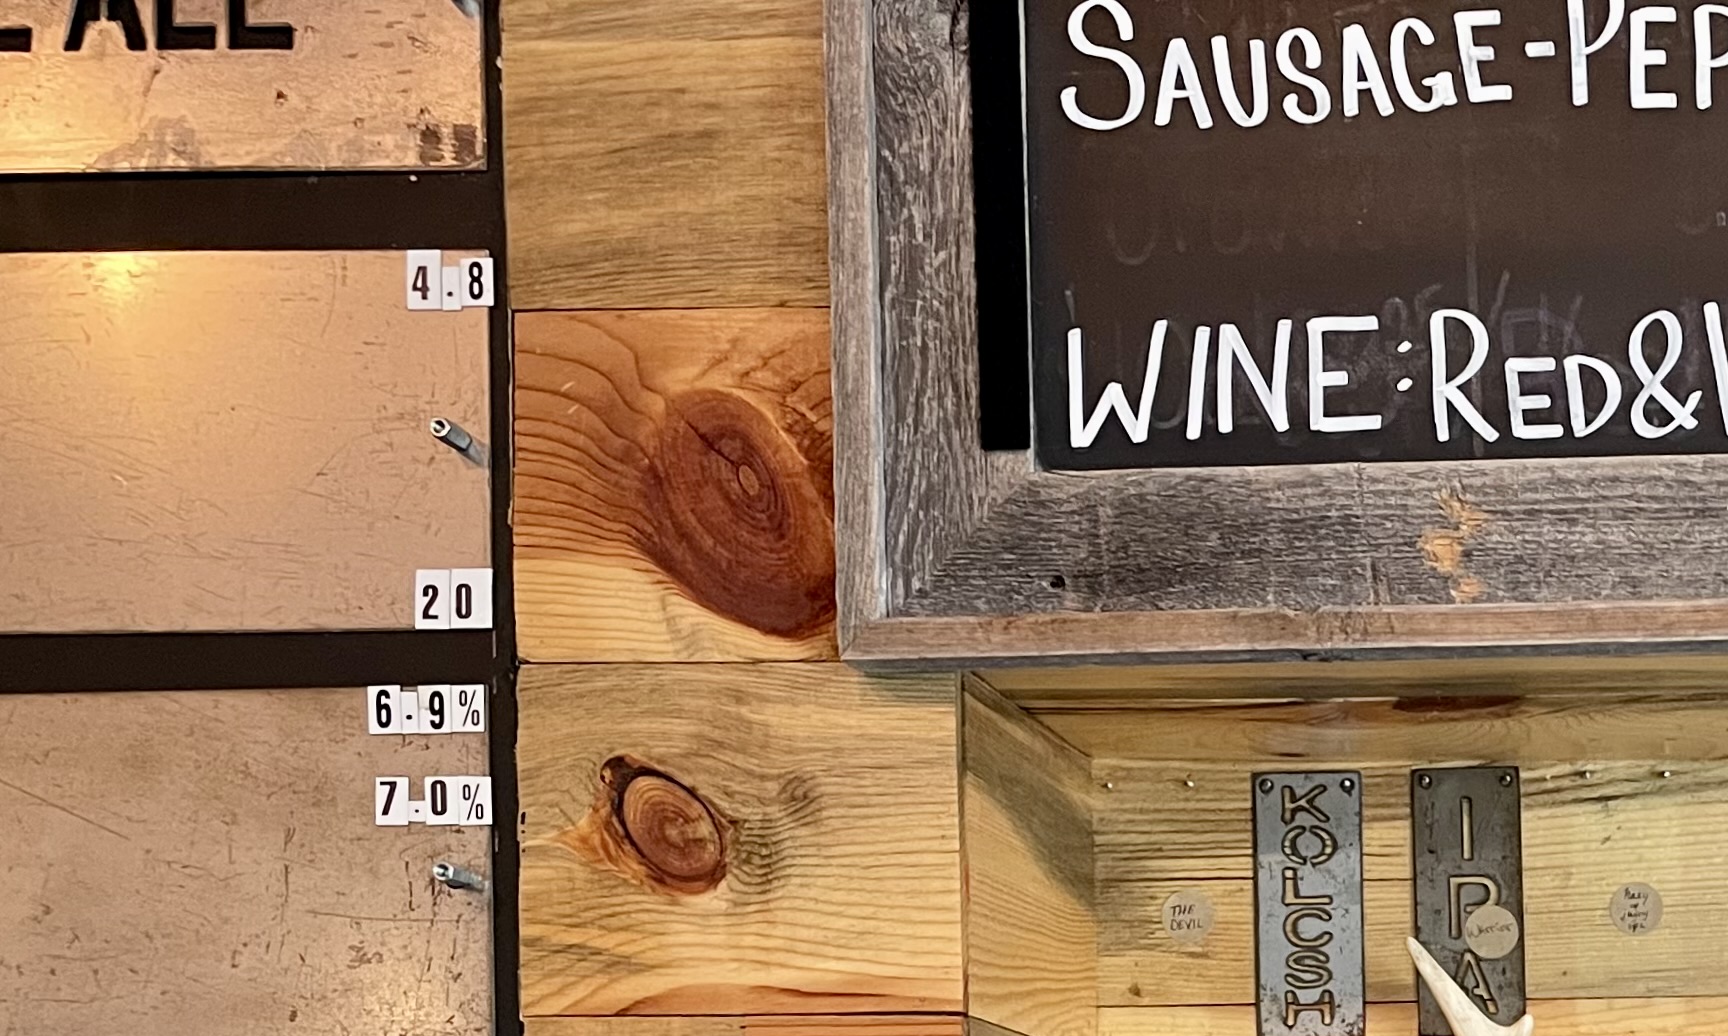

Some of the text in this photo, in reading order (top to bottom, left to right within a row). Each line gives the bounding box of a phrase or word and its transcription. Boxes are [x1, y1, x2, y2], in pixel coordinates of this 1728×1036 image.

[412, 261, 485, 301] 4.8
[421, 583, 473, 621] 20
[375, 688, 481, 730] 6.9%
[379, 779, 484, 821] 7.0%
[1170, 918, 1204, 931] DEVIL
[1280, 783, 1338, 1030] KOLCSH
[1448, 796, 1500, 1015] IPA
